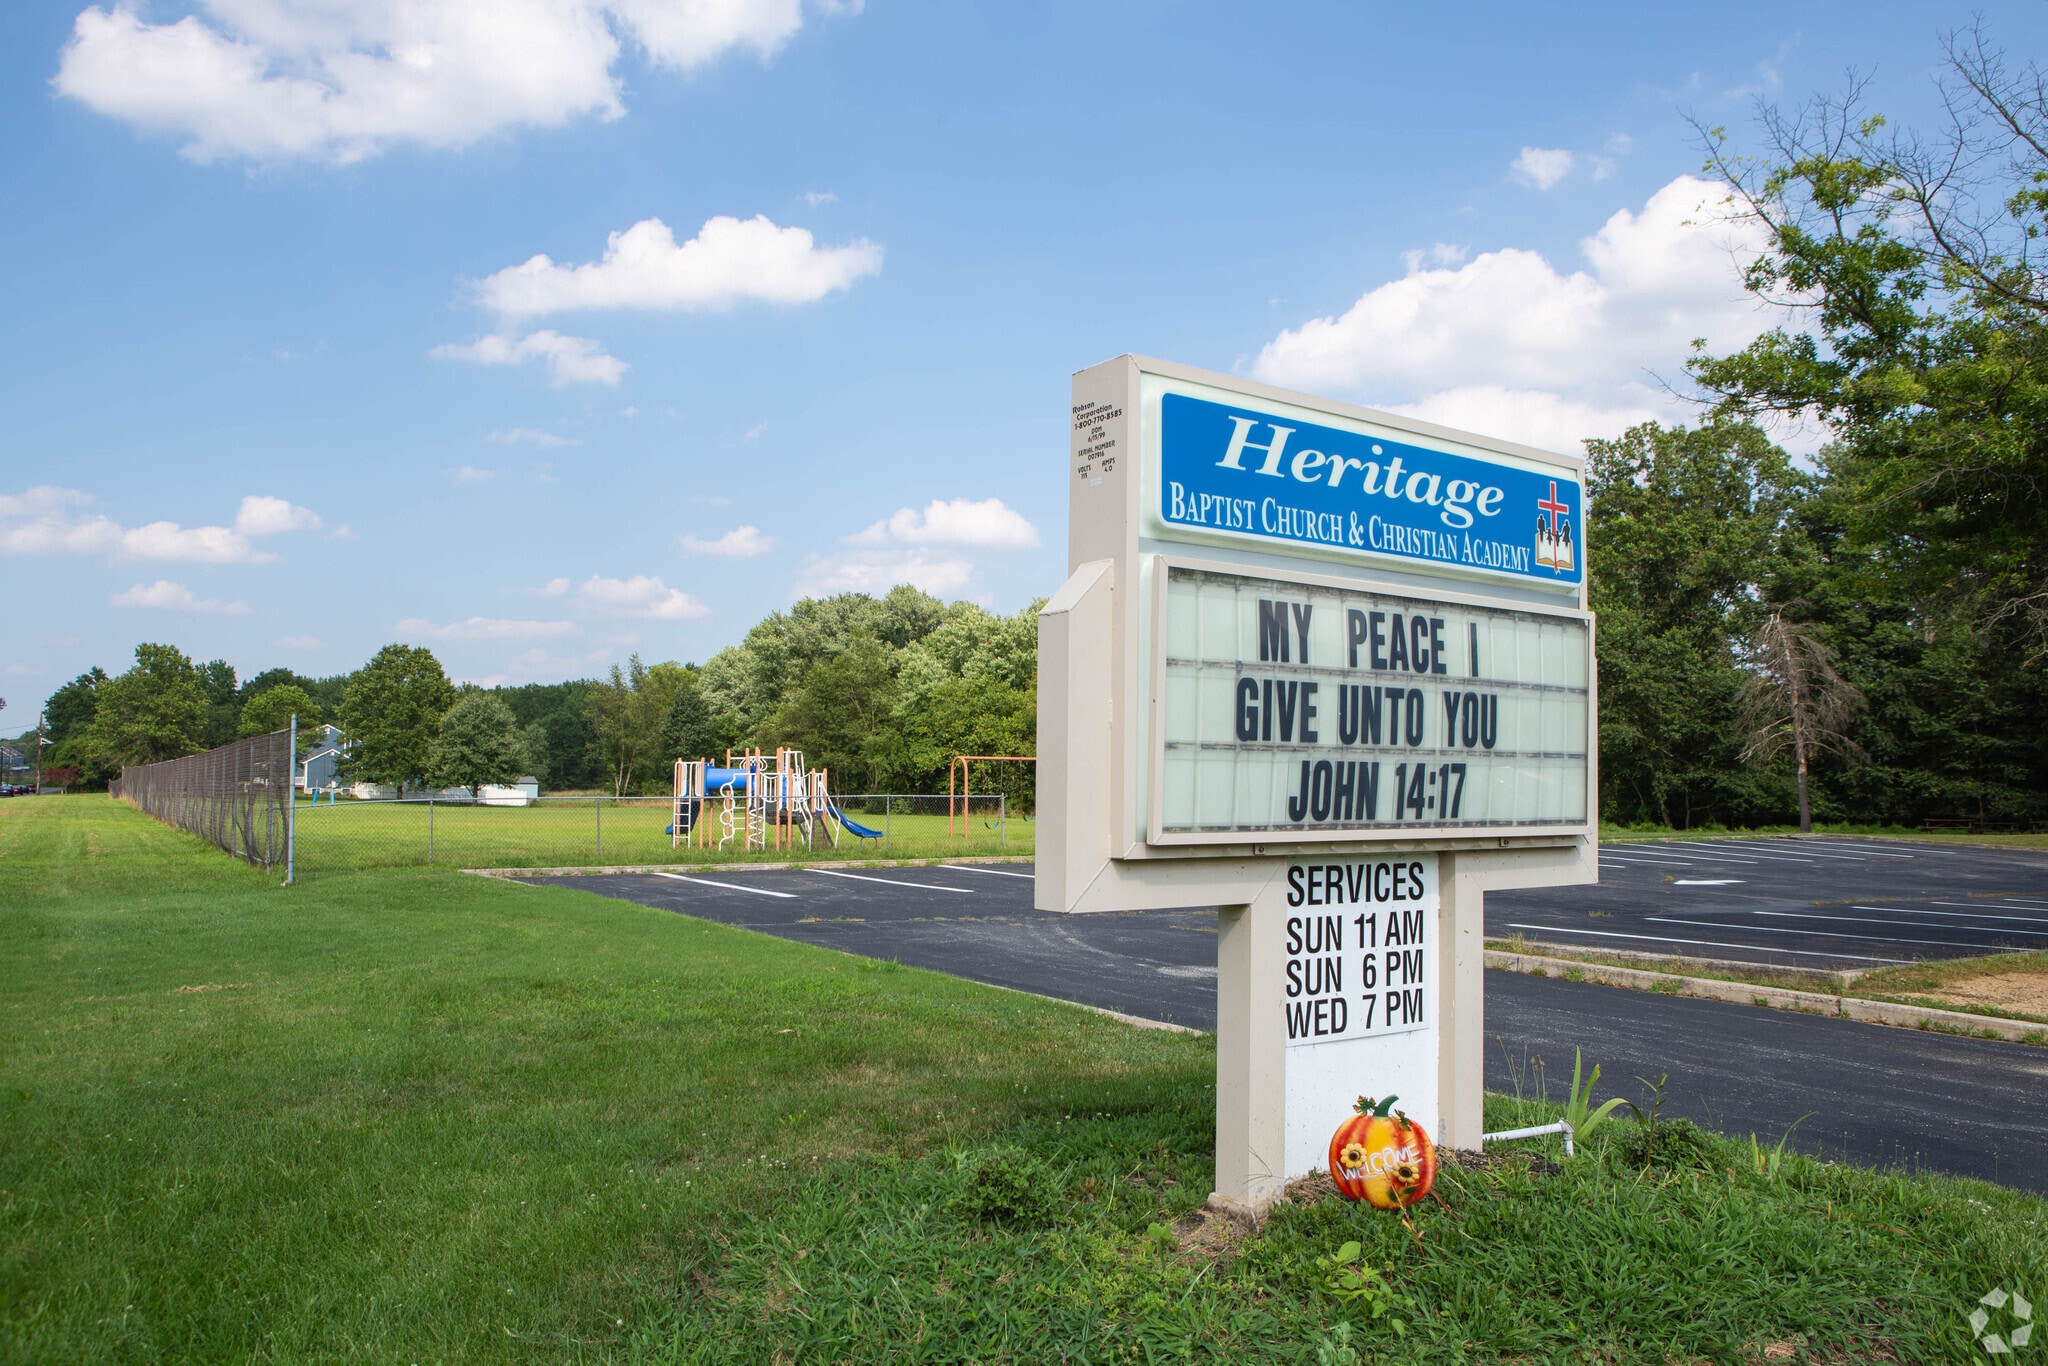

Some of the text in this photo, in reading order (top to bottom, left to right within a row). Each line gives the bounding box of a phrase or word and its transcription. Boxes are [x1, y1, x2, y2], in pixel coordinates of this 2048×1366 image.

[1072, 402, 1095, 414] Robson
[1074, 409, 1123, 431] 1-800-770-8585
[1076, 404, 1113, 421] Corporation
[1078, 440, 1116, 457] SERIAL NUMBER
[1078, 457, 1116, 474] VOLTS AMPS
[1215, 415, 1505, 529] Heritage
[1169, 481, 1531, 572] BAPTIST CHURCH & CHRISTIAN ACADEMY
[1258, 599, 1479, 677] MY PEACE I
[1236, 677, 1498, 750] GIVE UNTO YOU
[1288, 759, 1467, 822] JOHN 14:17
[1287, 861, 1425, 908] SERVICES
[1286, 910, 1424, 956] SUN 11 AM
[1286, 949, 1424, 998] SUN 6 PM
[1286, 988, 1424, 1040] WED 7 PM
